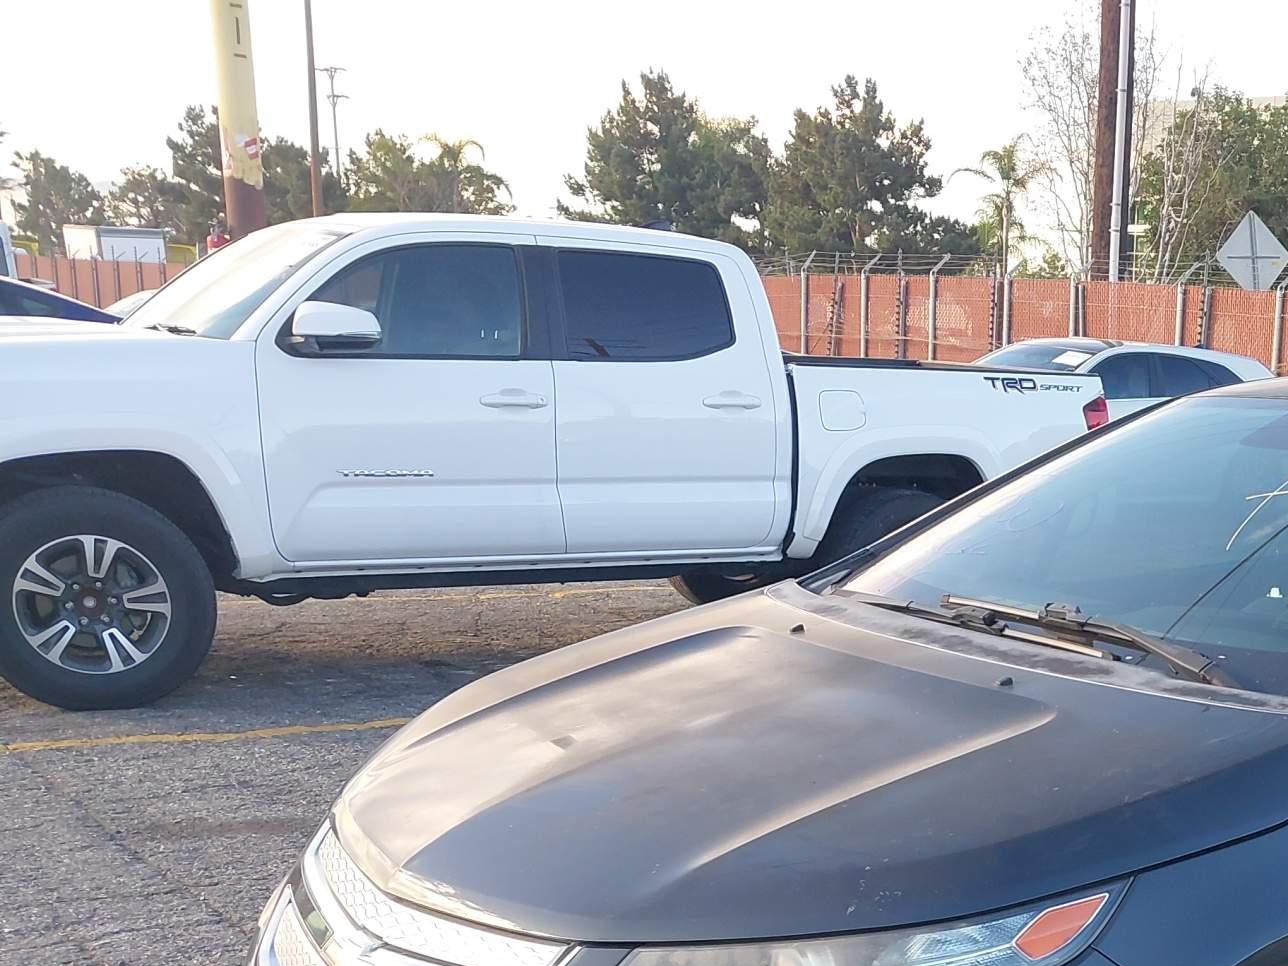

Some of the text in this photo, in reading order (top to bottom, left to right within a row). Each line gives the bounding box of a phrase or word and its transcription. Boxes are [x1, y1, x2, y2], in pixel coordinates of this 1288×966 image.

[983, 376, 1084, 395] TRD SPORT
[335, 469, 434, 478] TACOMA
